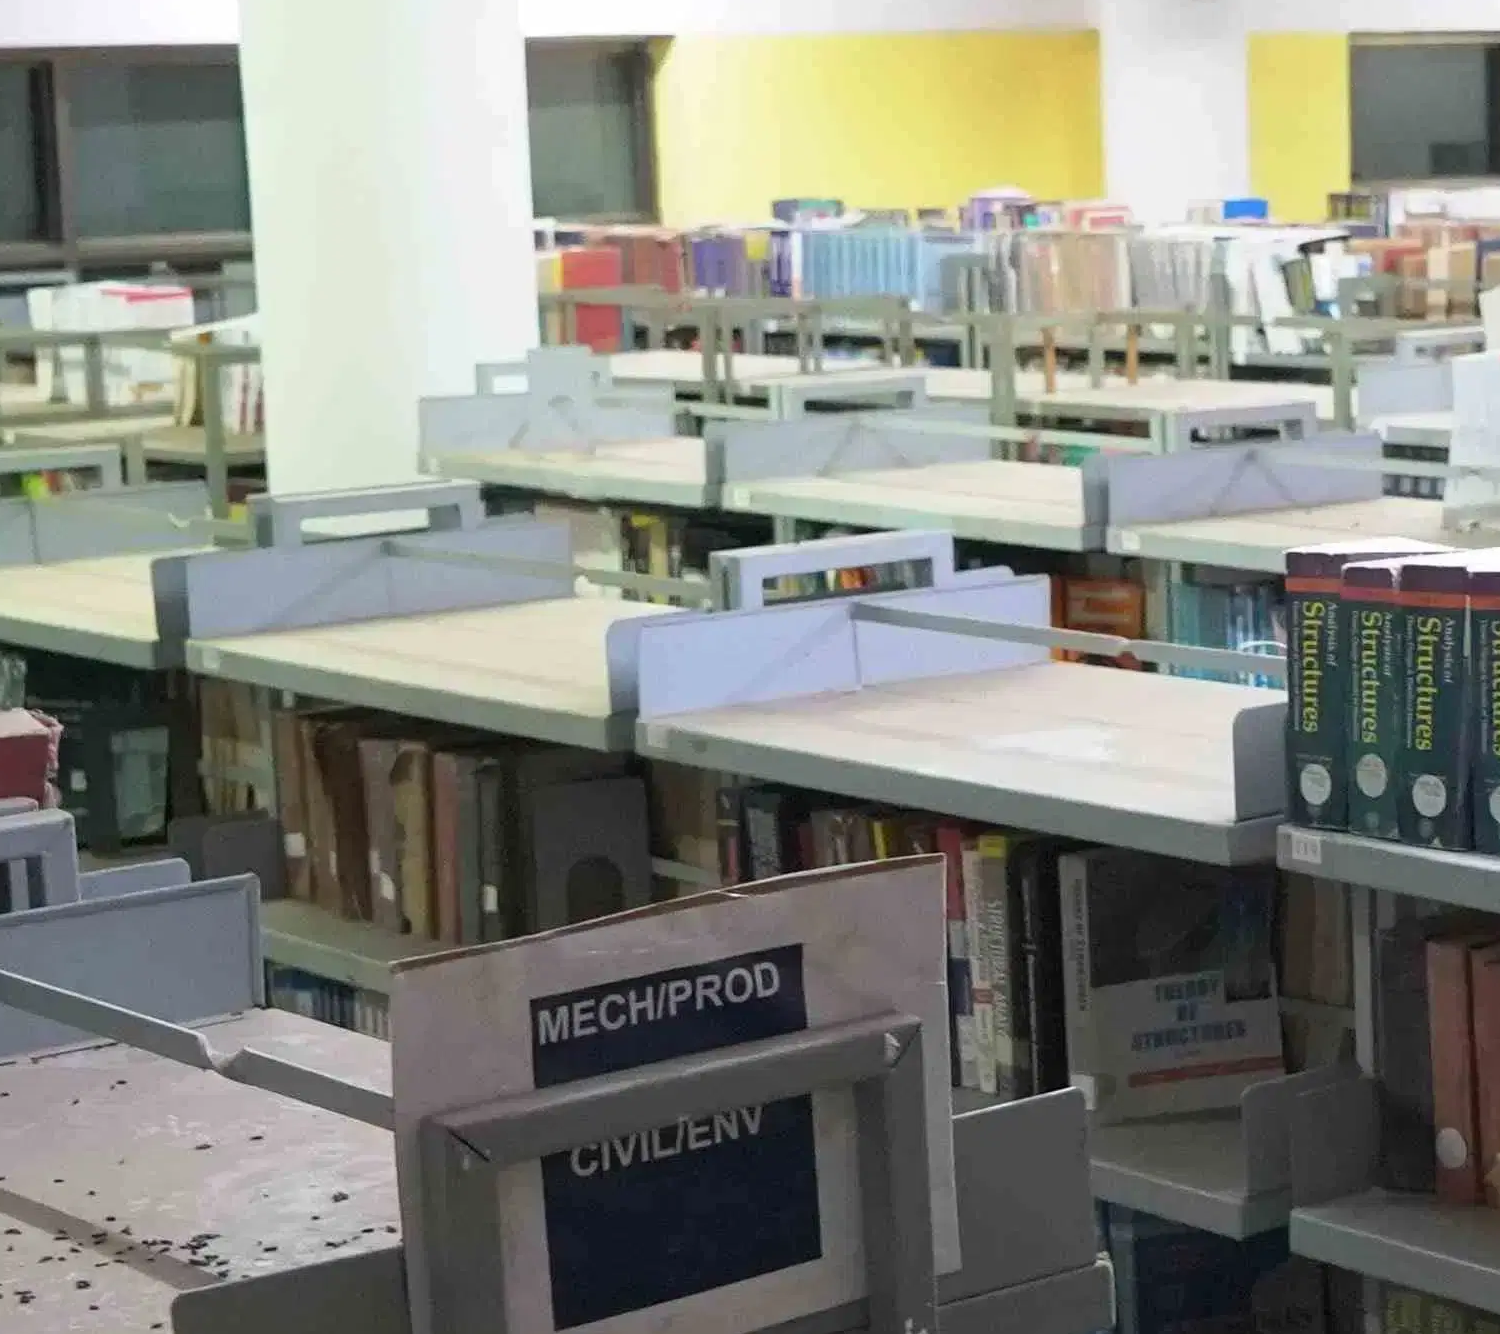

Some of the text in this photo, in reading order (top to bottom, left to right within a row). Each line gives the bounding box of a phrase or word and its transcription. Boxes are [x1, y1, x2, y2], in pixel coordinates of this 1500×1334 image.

[1300, 601, 1324, 732] Structures
[1327, 602, 1338, 666] Analysis of
[1383, 612, 1392, 676] Analysis of
[1444, 616, 1455, 683] Analysis of
[1361, 611, 1381, 743] Structures
[1415, 616, 1441, 750] Structures
[538, 961, 780, 1045] MECH/PROD
[570, 1104, 762, 1177] CIVIL/ENV
